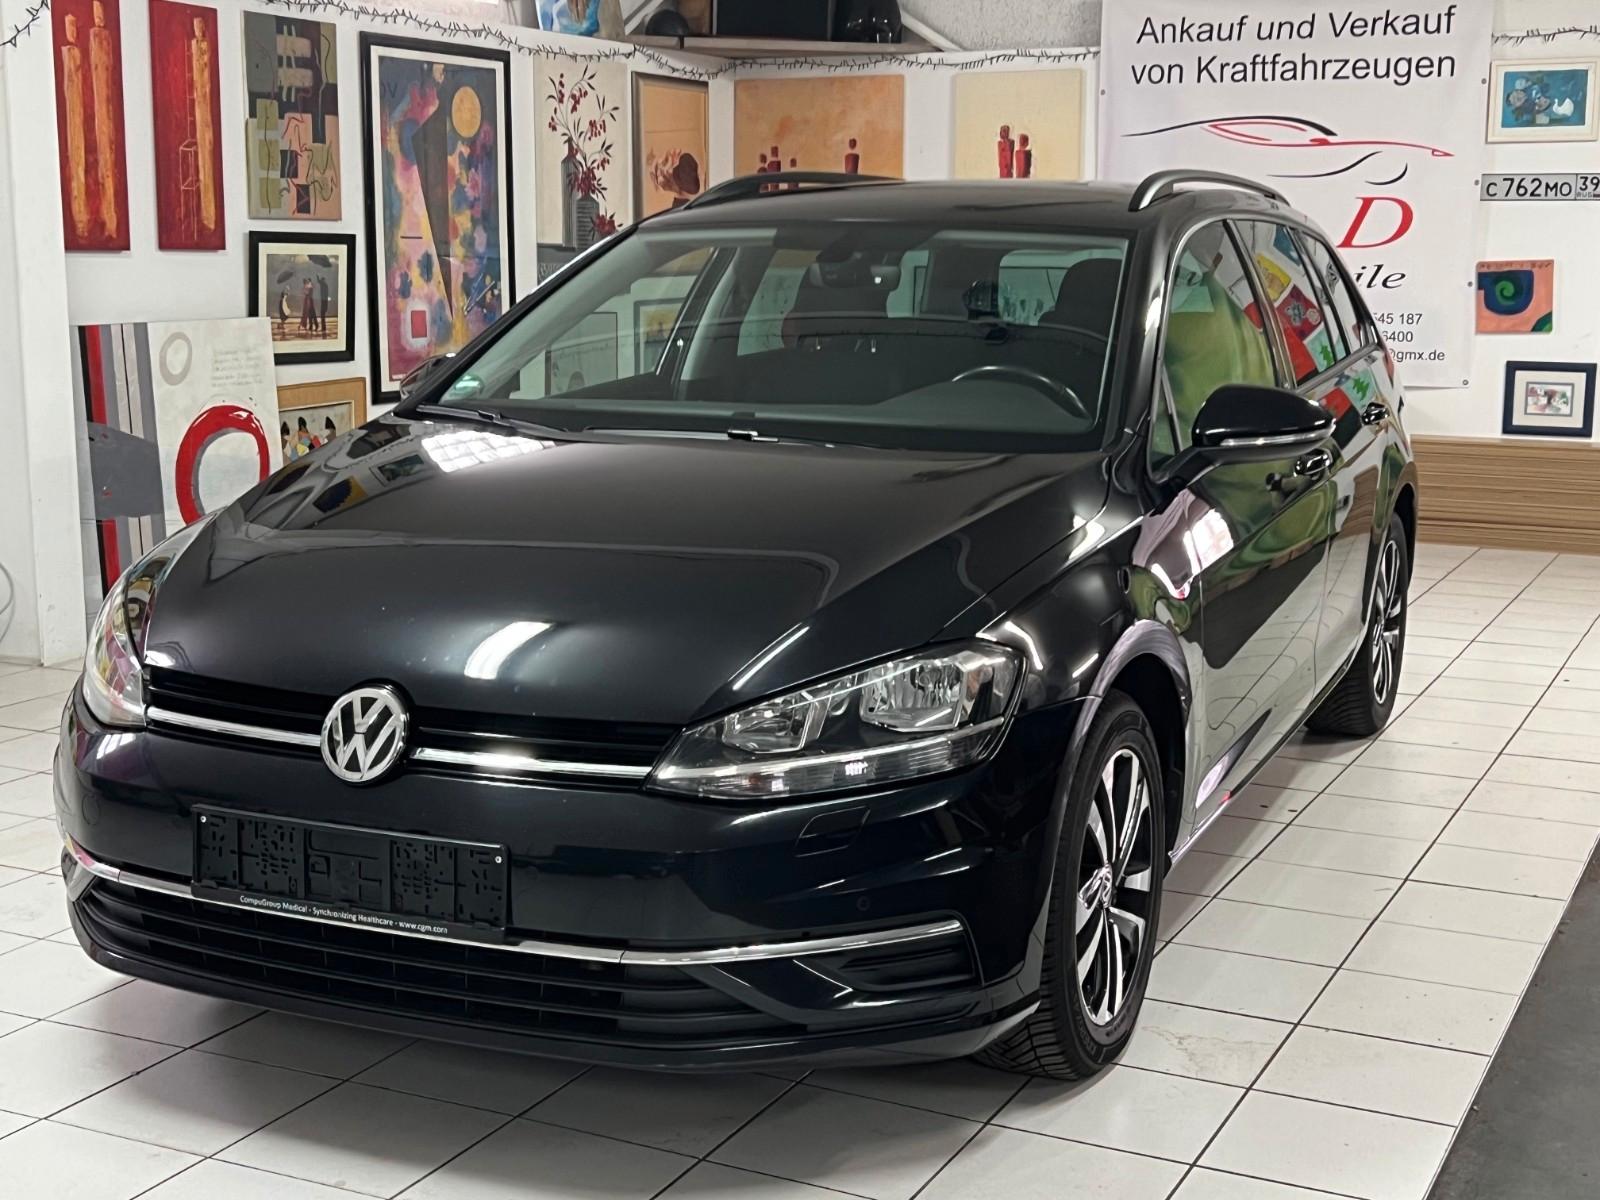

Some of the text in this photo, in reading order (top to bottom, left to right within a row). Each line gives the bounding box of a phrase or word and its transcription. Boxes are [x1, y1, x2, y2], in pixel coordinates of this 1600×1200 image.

[1136, 4, 1457, 44] Ankauf und Verkauf
[1131, 52, 1456, 86] von Kraftfahrzeugen
[1579, 175, 1600, 192] 39
[1336, 196, 1414, 248] D
[1353, 263, 1406, 289] ile
[1399, 313, 1423, 325] 187
[320, 687, 406, 782] VW
[239, 895, 282, 910] CompuGroup
[282, 902, 308, 913] Medical
[312, 907, 357, 922] Synchronizing
[357, 914, 394, 926] Healthcare
